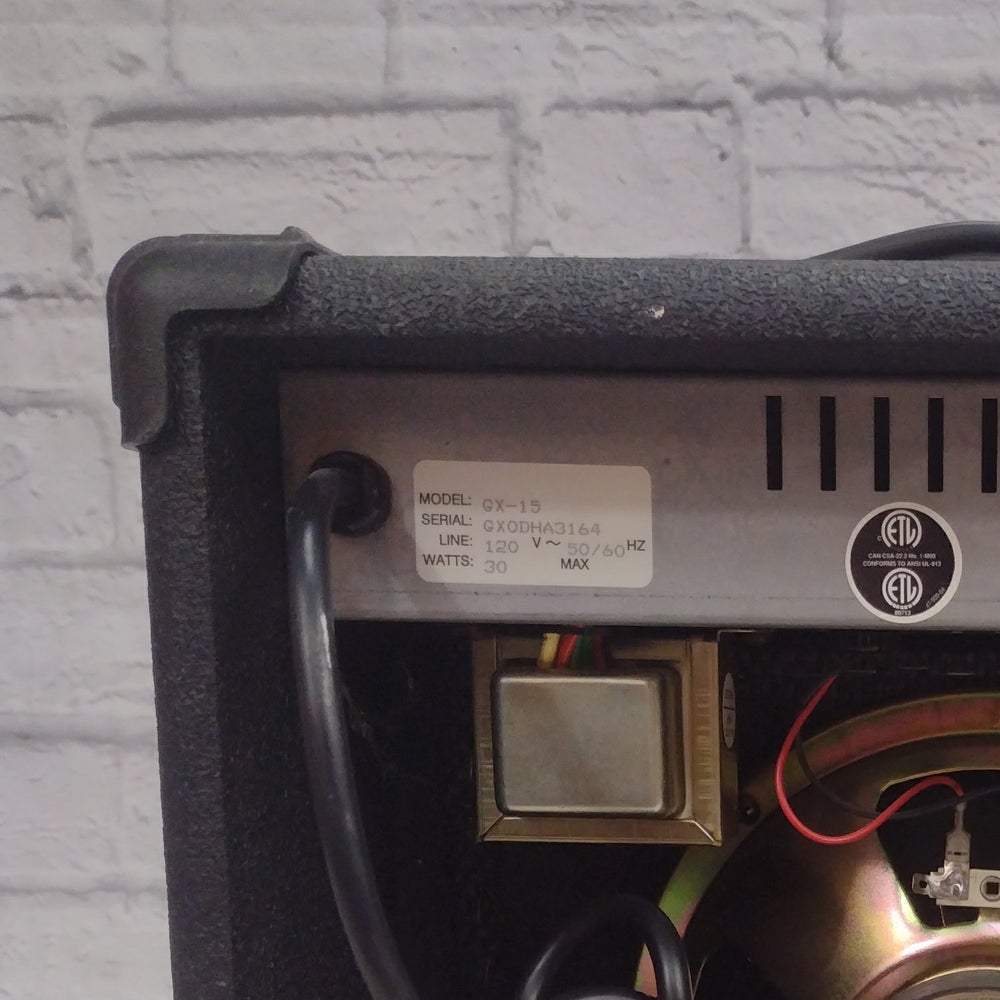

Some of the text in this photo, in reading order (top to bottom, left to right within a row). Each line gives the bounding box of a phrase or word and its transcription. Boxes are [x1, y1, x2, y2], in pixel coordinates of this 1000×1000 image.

[419, 493, 541, 514] MODEL: GX-15
[422, 514, 472, 526] SERIAL:
[887, 516, 916, 546] ETL
[440, 535, 473, 547] LINE:
[486, 540, 519, 554] 120
[567, 543, 625, 558] 50/60
[627, 540, 646, 551] HZ
[423, 555, 589, 574] WATTS: 30 MAX
[887, 573, 917, 604] ETL
